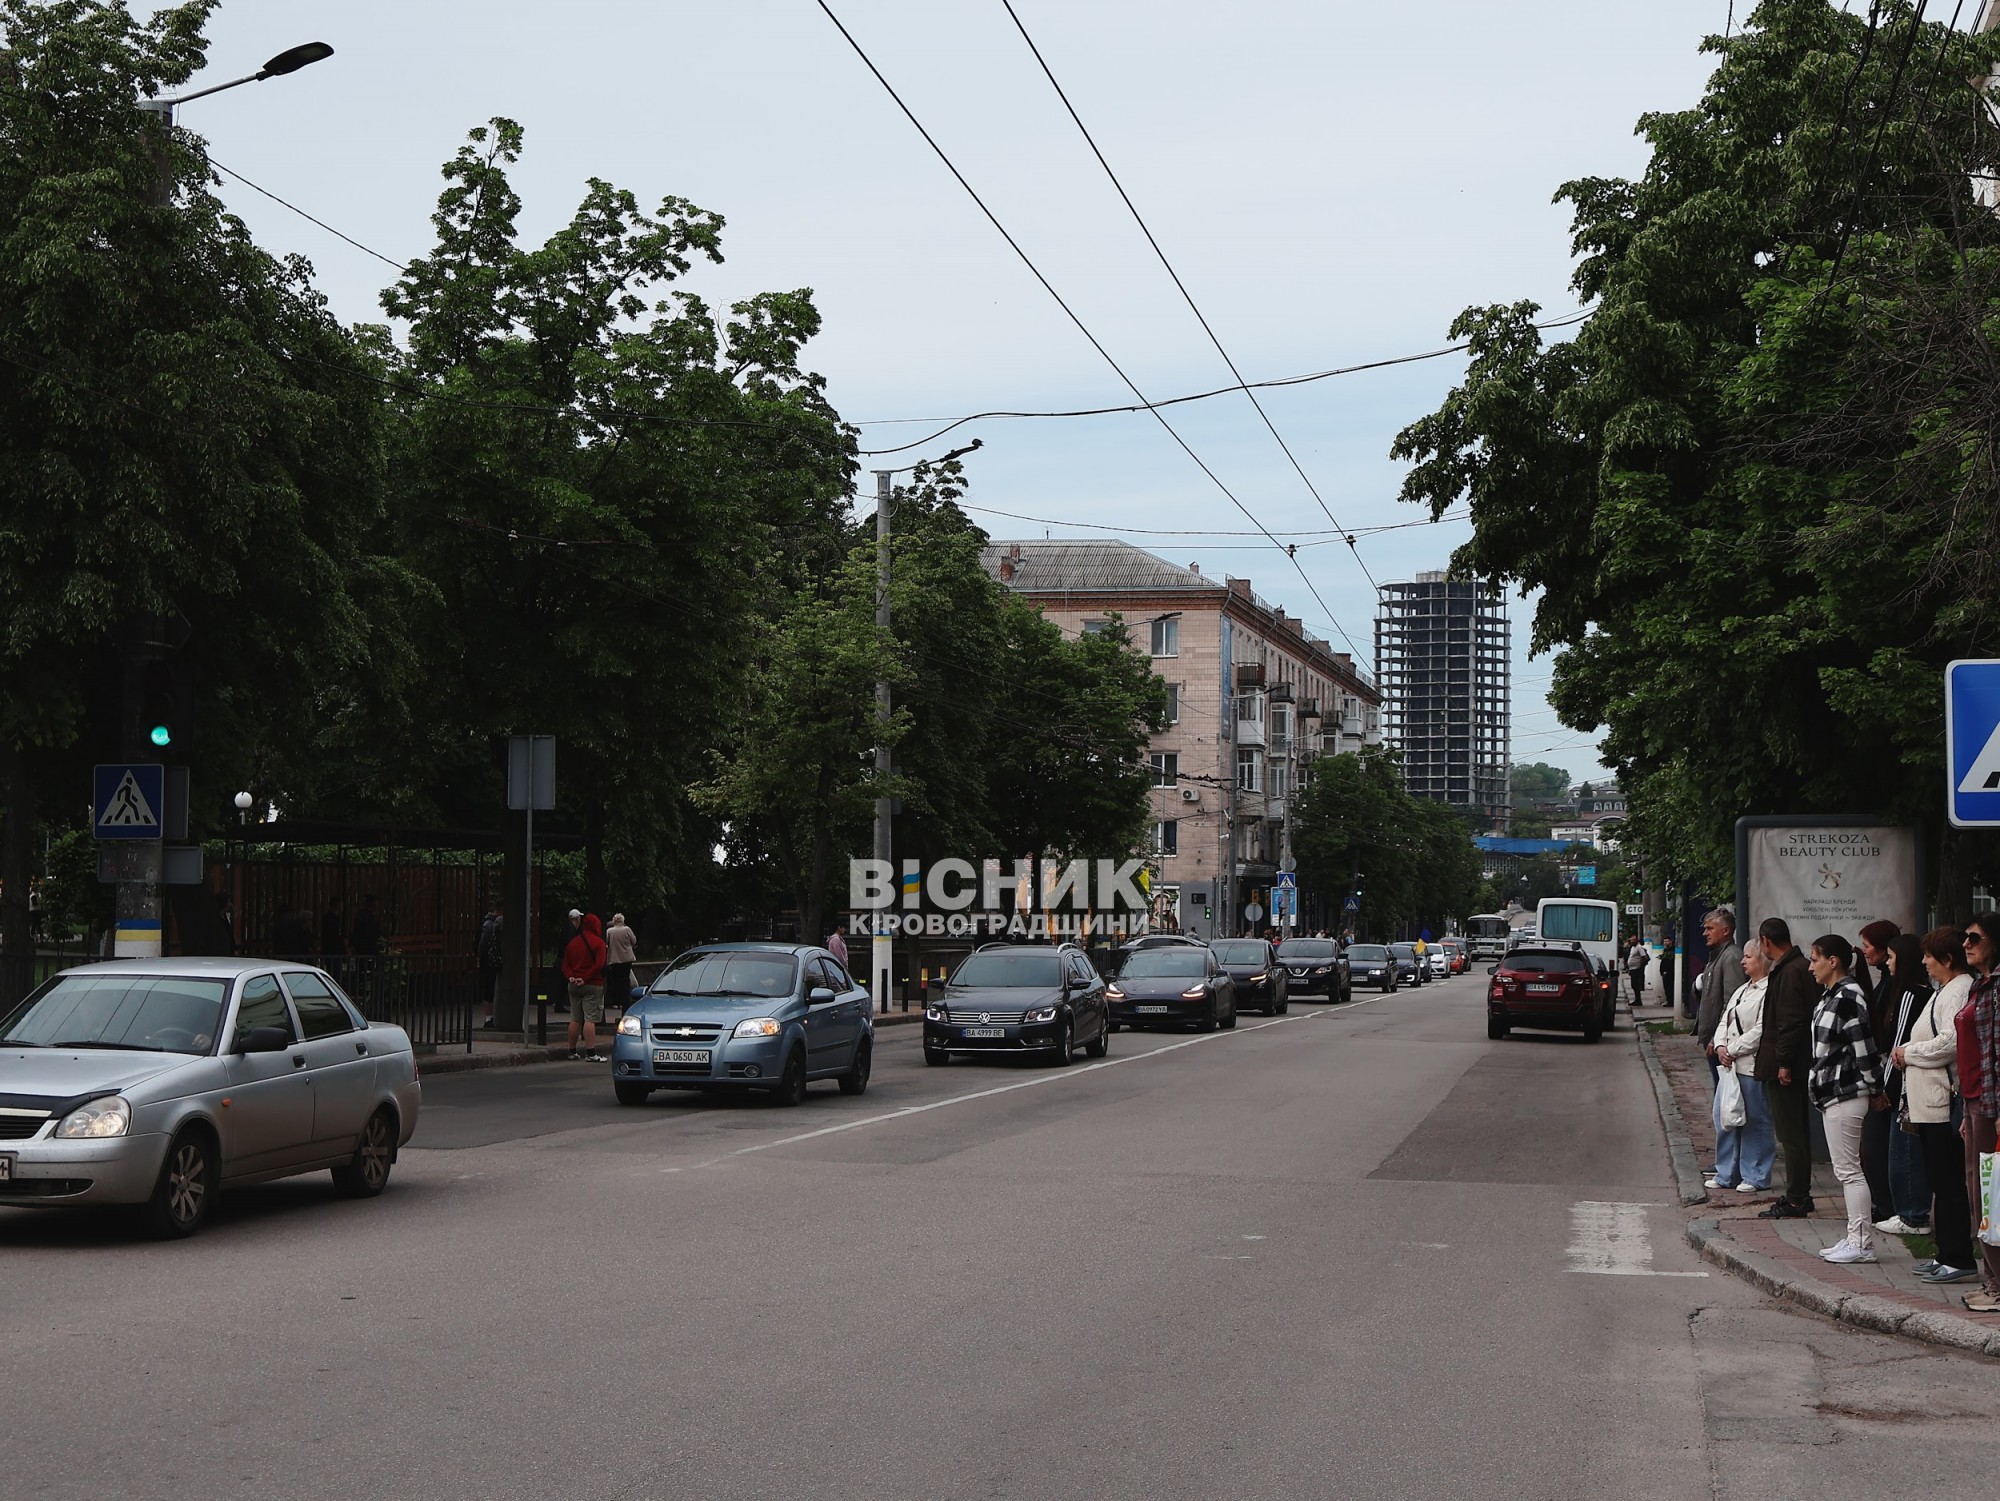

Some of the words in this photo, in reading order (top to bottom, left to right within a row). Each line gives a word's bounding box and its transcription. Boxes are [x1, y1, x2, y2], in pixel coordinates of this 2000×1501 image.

[1789, 834, 1870, 844] STREKOZA
[1779, 847, 1837, 857] BEAUTY
[1841, 847, 1881, 857] CLUB
[658, 1052, 671, 1061] BA
[673, 1052, 693, 1062] 0650
[695, 1053, 708, 1062] AK
